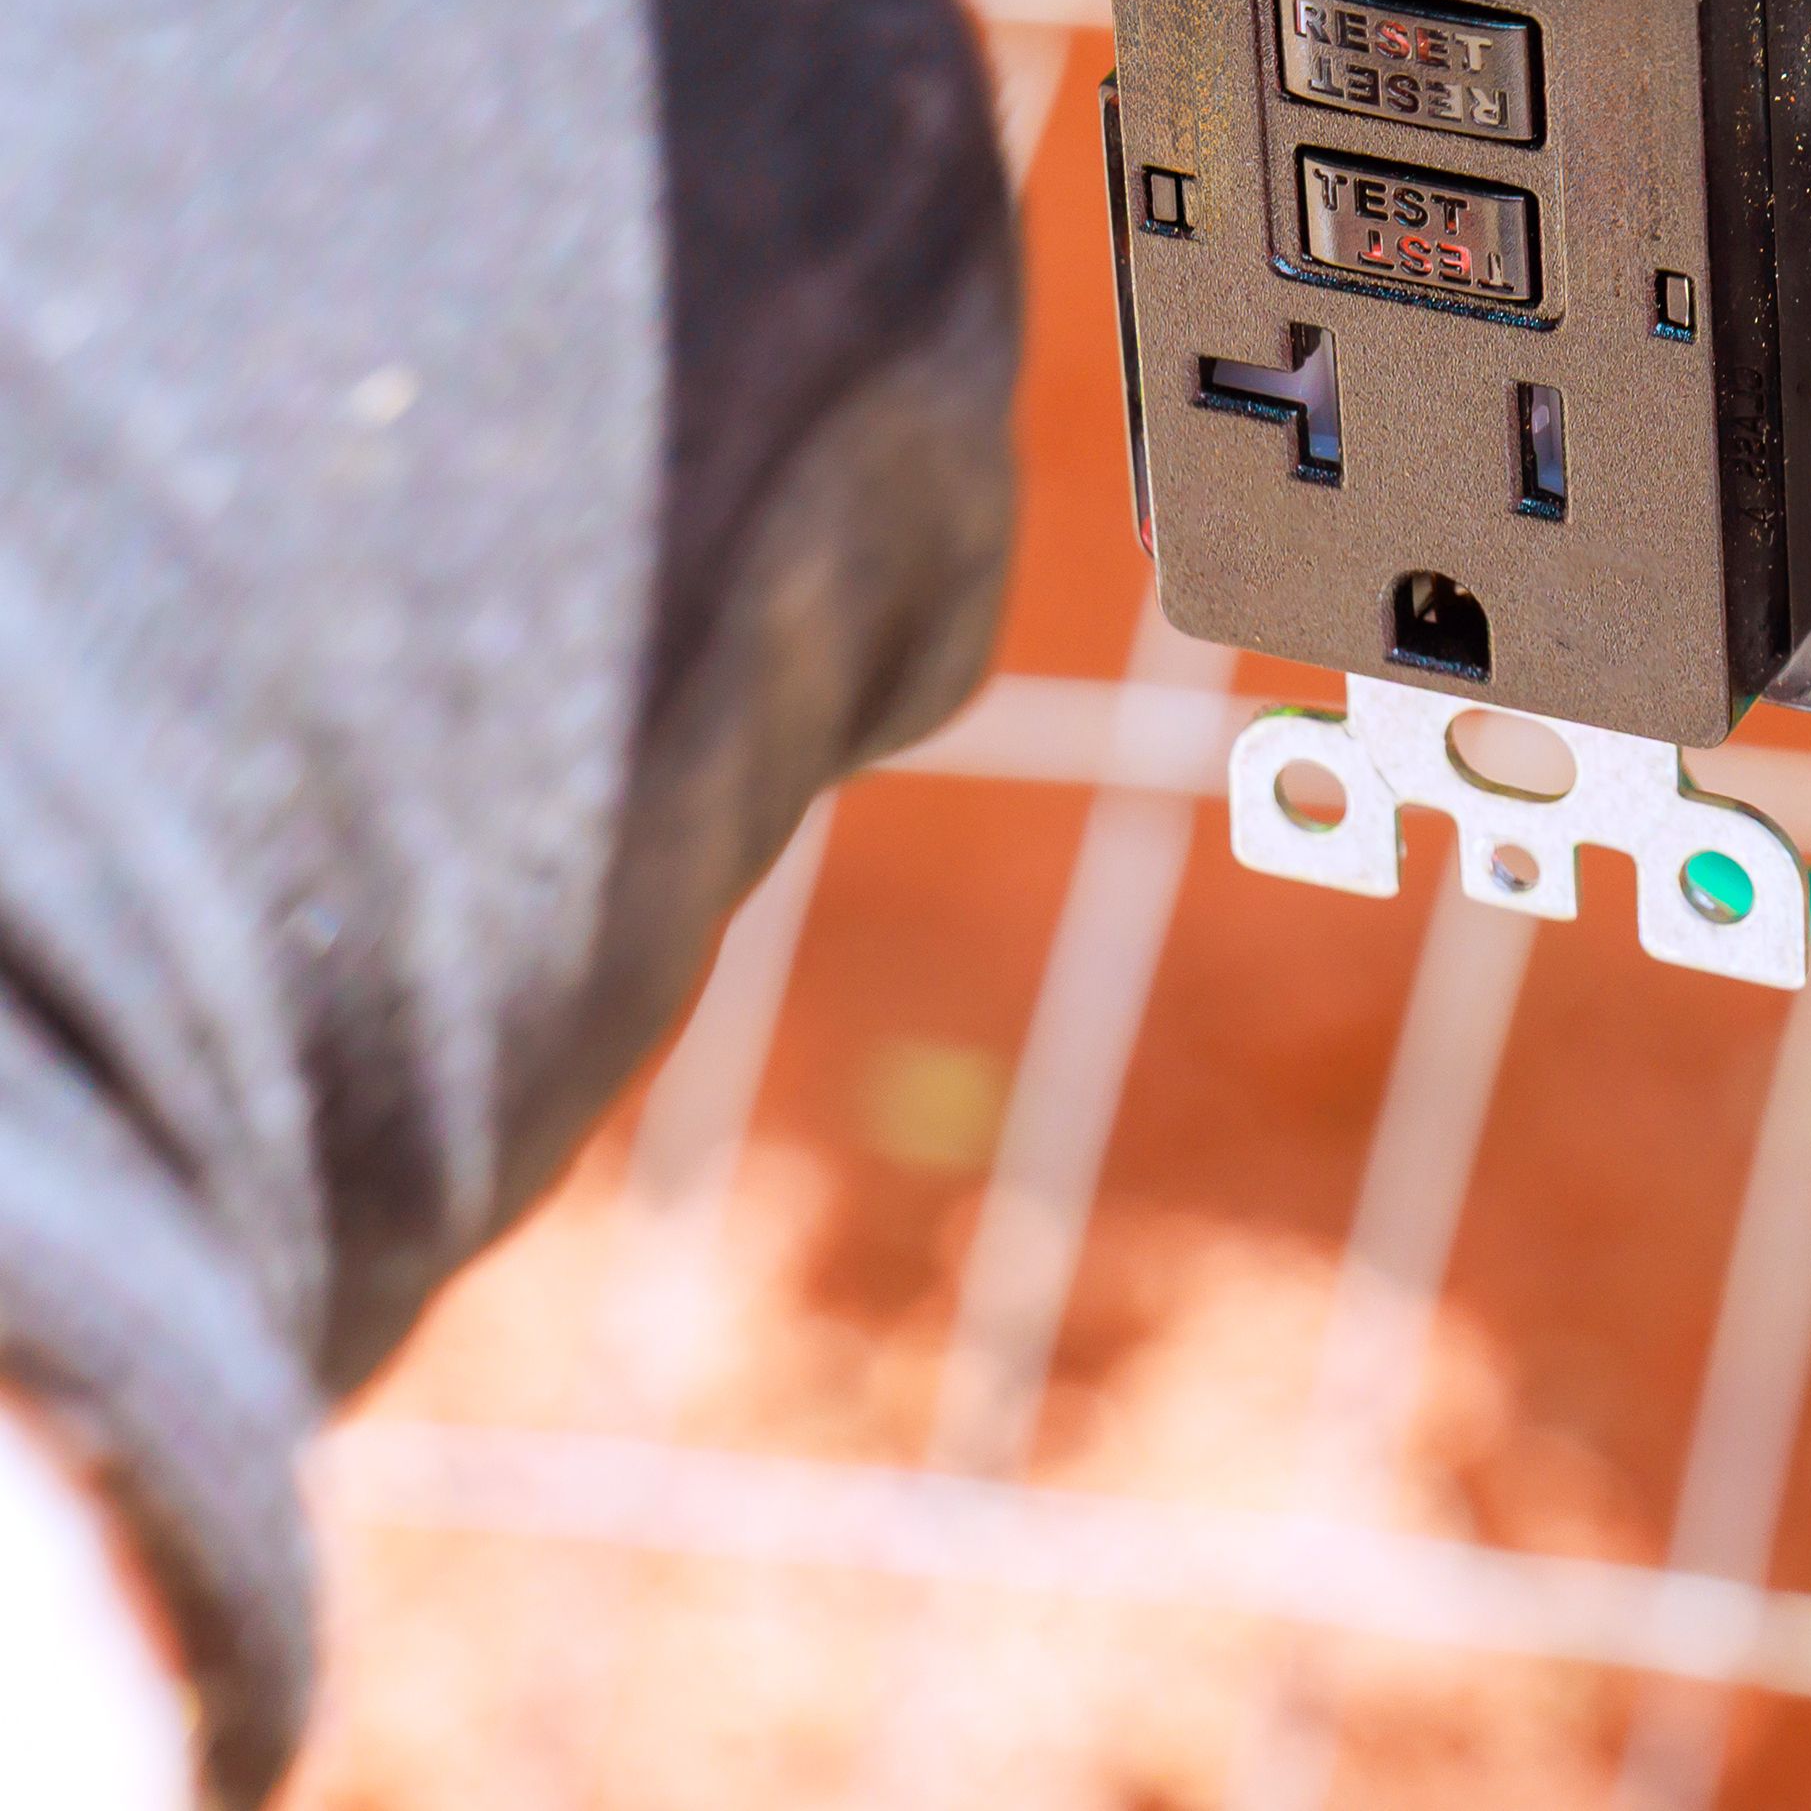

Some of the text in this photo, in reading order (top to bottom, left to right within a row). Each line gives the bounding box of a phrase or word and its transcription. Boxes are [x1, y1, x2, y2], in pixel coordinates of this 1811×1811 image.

[1308, 54, 1510, 130] RESET
[1312, 167, 1469, 236] TEST
[1356, 229, 1515, 293] TEST
